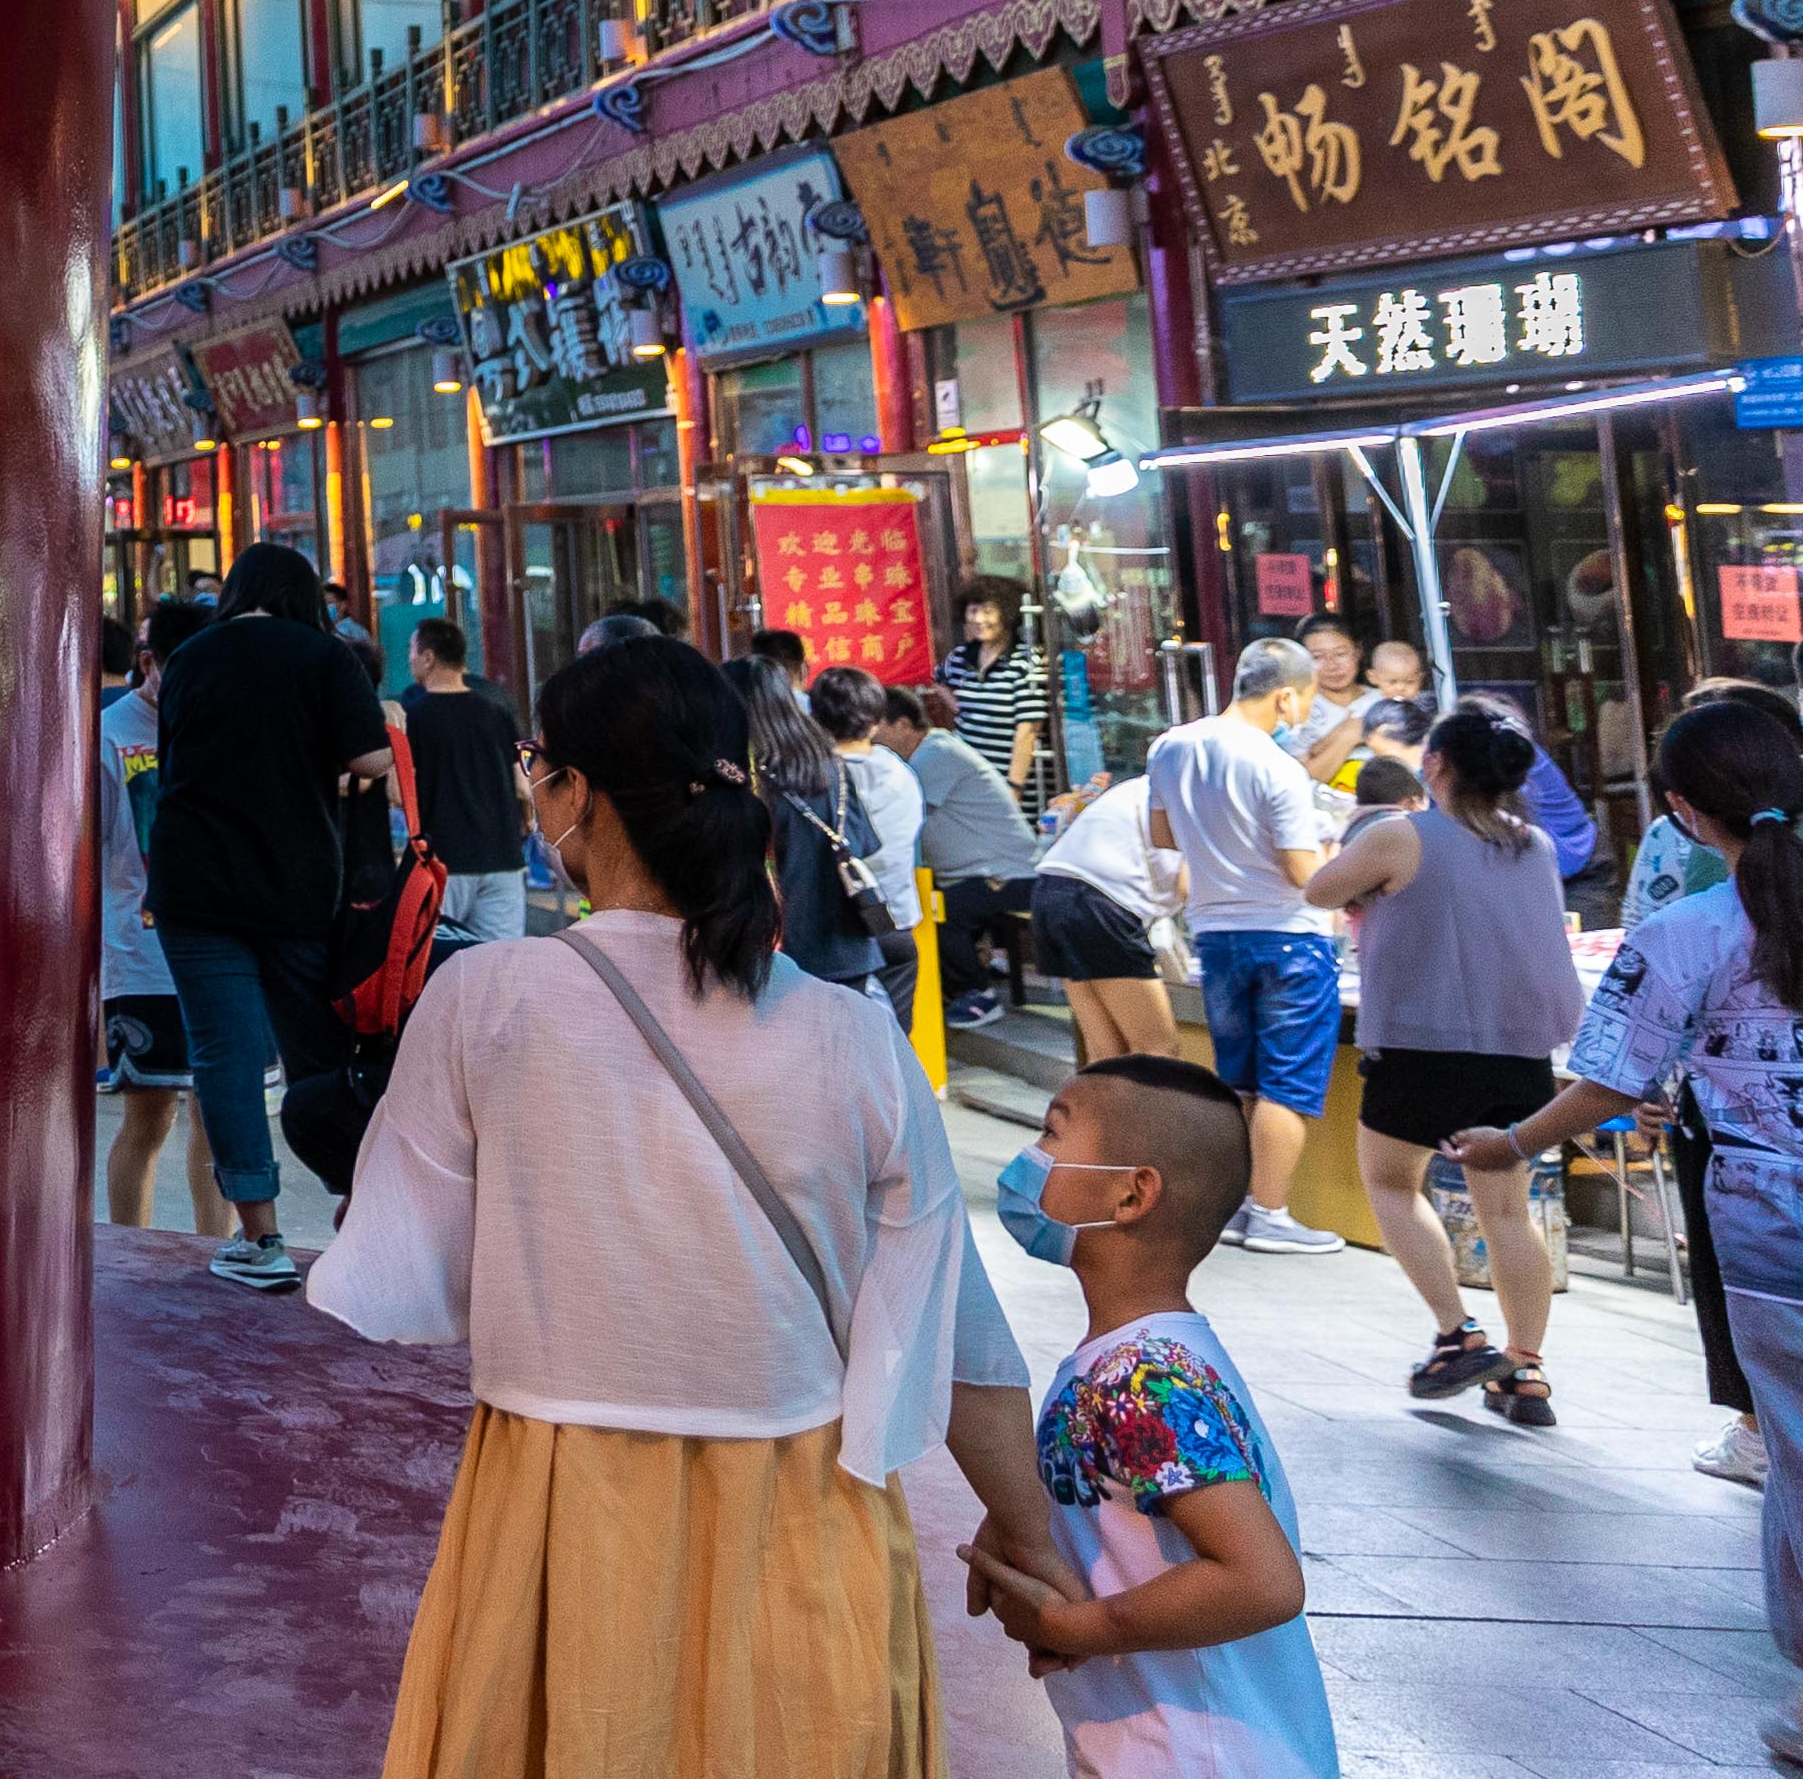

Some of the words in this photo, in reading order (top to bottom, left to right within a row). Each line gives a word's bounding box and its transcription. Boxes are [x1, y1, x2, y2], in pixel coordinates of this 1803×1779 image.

[1253, 17, 1645, 212] 畅铭阁
[1203, 140, 1259, 245] 北京
[1308, 271, 1586, 384] 天然珊瑚
[777, 527, 908, 557] 欢迎光临
[782, 560, 914, 593] 专业串珠
[785, 597, 917, 629] 精品珠宝
